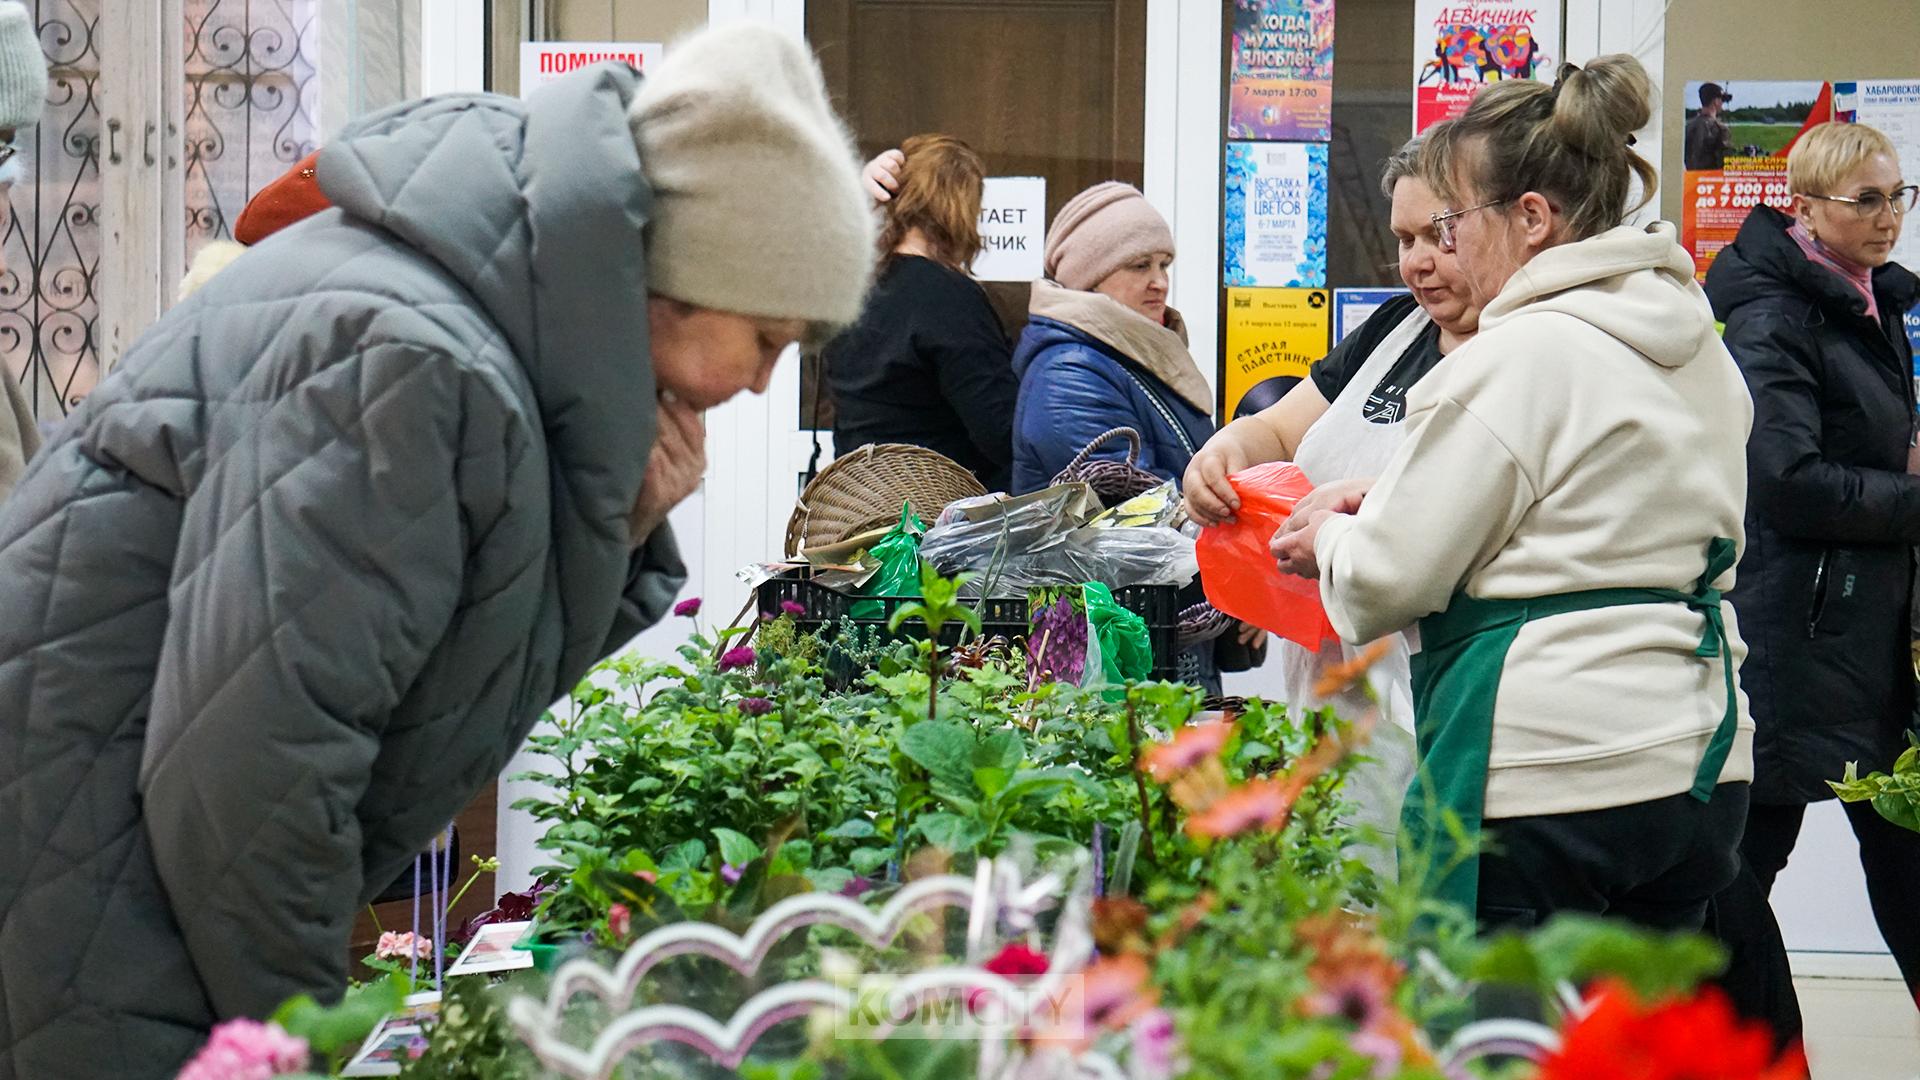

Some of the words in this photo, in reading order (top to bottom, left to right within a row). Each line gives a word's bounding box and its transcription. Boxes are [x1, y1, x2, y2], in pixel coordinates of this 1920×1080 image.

[1434, 7, 1537, 27] ДЕВИЧНИК
[1244, 31, 1320, 49] МУЖЧИНА
[1243, 87, 1250, 95] 7
[1252, 89, 1286, 97] марта
[1289, 87, 1318, 97] 17:00
[1696, 184, 1715, 195] от
[1720, 183, 1731, 195] 4
[1734, 183, 1762, 195] 000
[1254, 200, 1302, 216] ЦВЕТОВ
[1732, 195, 1760, 208] 000
[1763, 195, 1793, 208] 000
[1237, 341, 1287, 362] СТАРАЯ
[1242, 352, 1313, 374] ПЛАСТИНК
